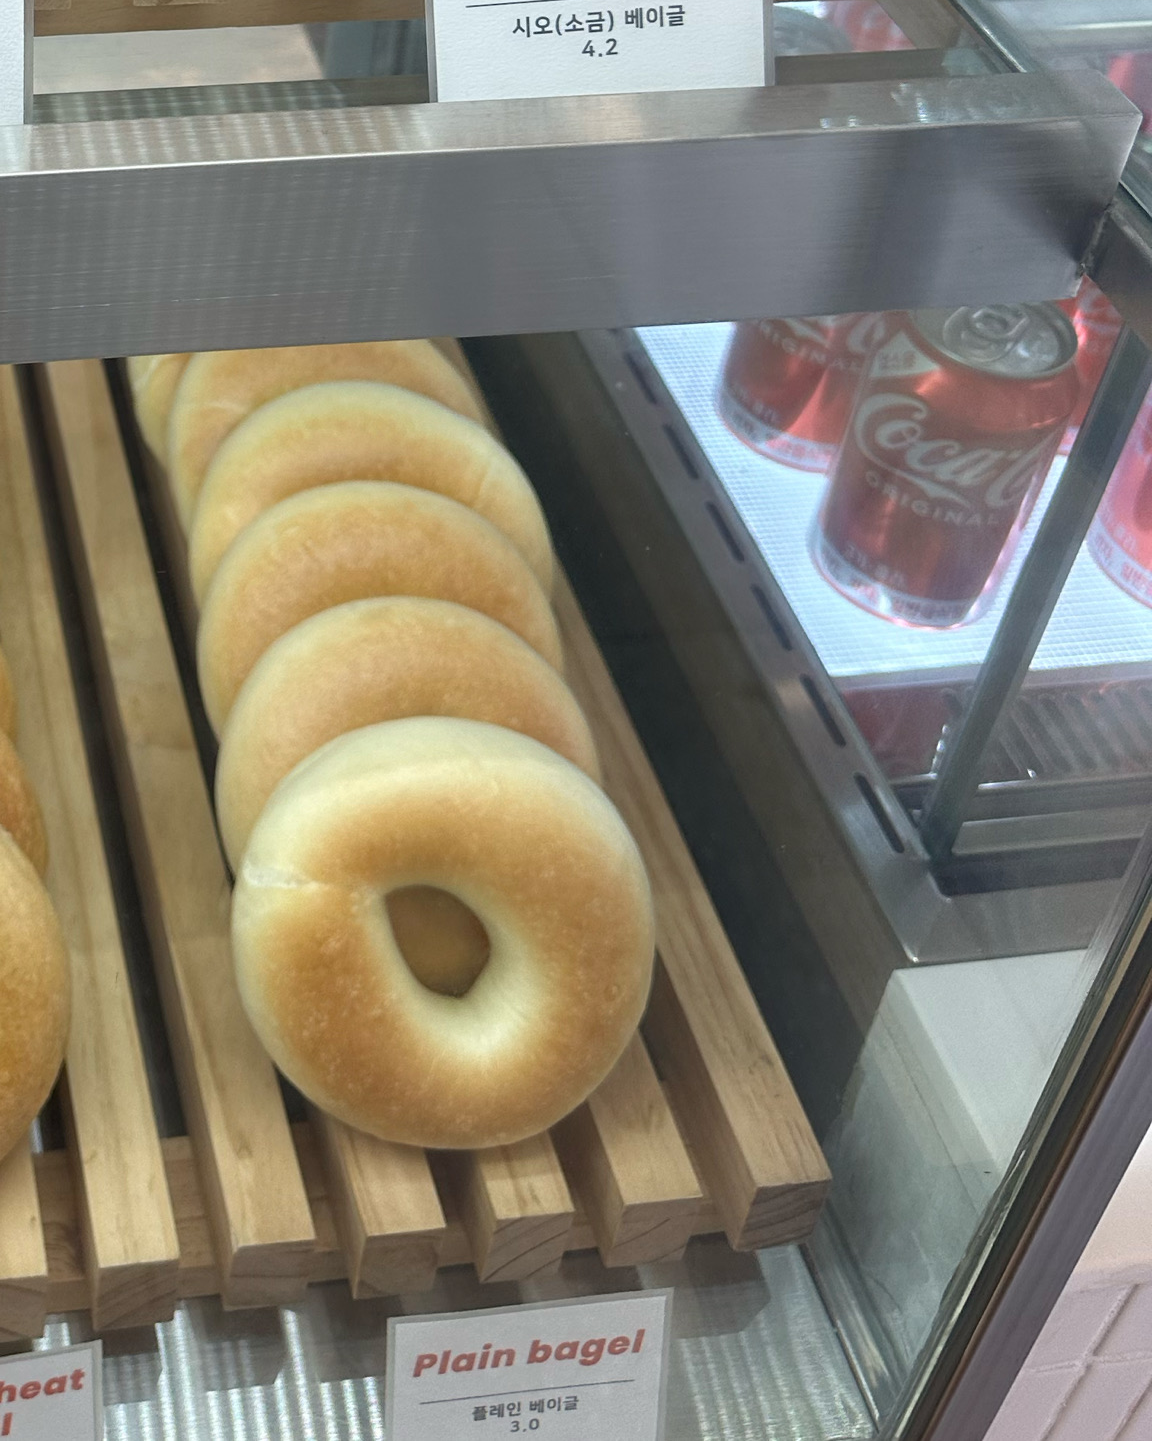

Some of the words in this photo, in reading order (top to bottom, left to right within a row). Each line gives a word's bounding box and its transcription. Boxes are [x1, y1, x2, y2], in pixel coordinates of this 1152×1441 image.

[513, 11, 616, 38] 시오(소금)
[625, 5, 685, 28] 베이글
[582, 38, 618, 57] 4.2
[865, 470, 1000, 528] ORIGINAL
[414, 1342, 516, 1376] Plain
[528, 1328, 646, 1365] bagel
[472, 1402, 521, 1421] 플레인
[529, 1396, 579, 1413] 베이글
[511, 1419, 539, 1432] 3.0
